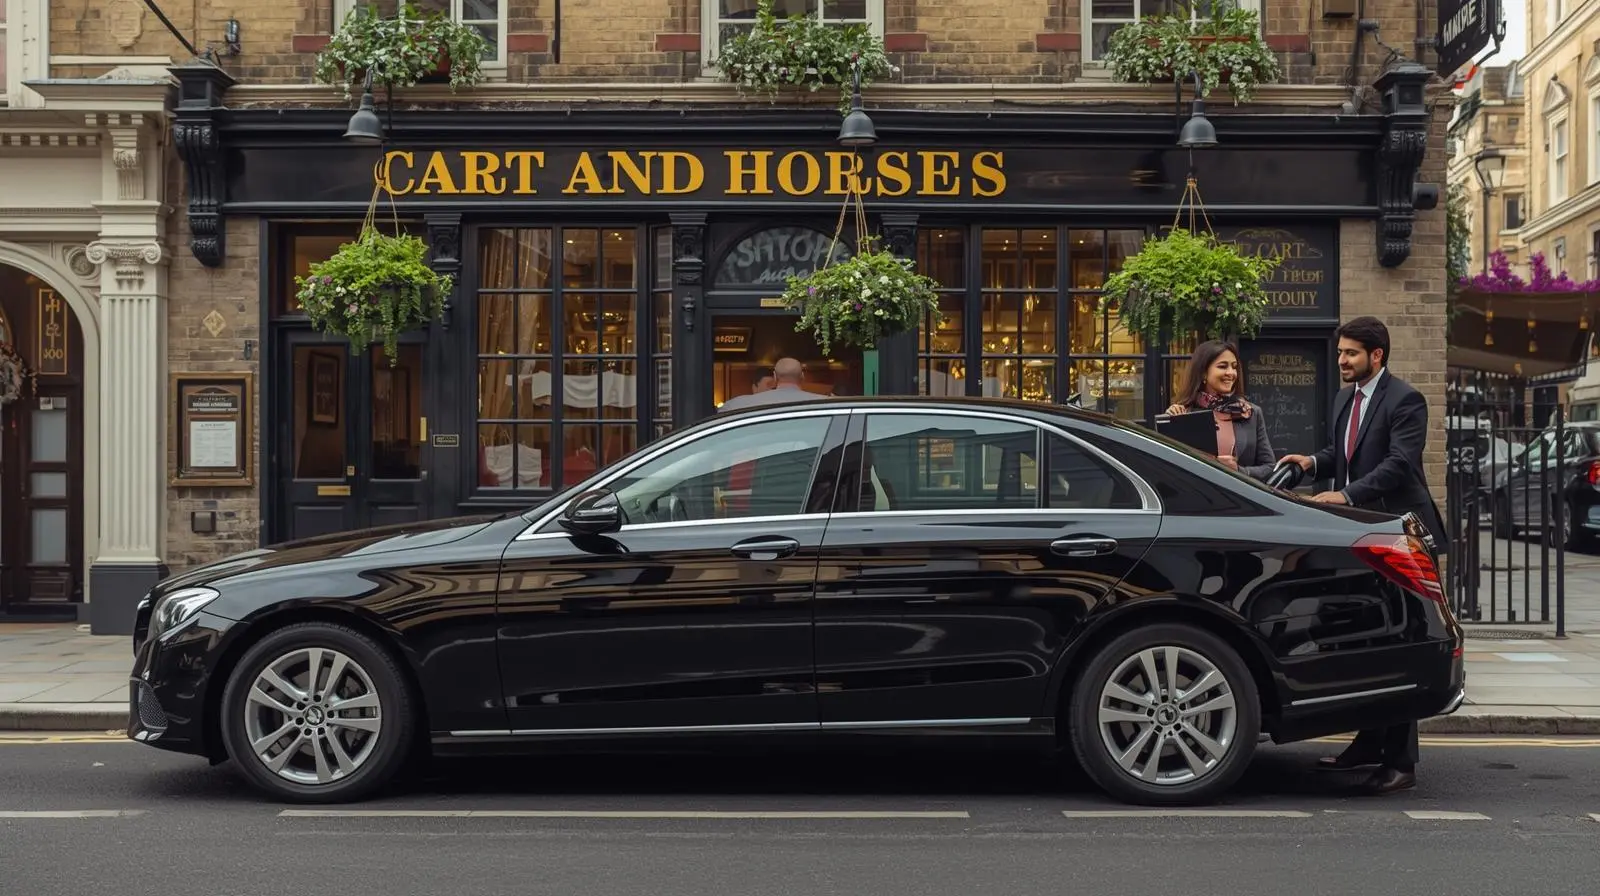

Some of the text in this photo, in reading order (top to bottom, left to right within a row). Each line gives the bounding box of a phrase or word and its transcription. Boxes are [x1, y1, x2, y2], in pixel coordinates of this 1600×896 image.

[384, 150, 1007, 196] CART AND HORSES
[1257, 242, 1305, 260] CART
